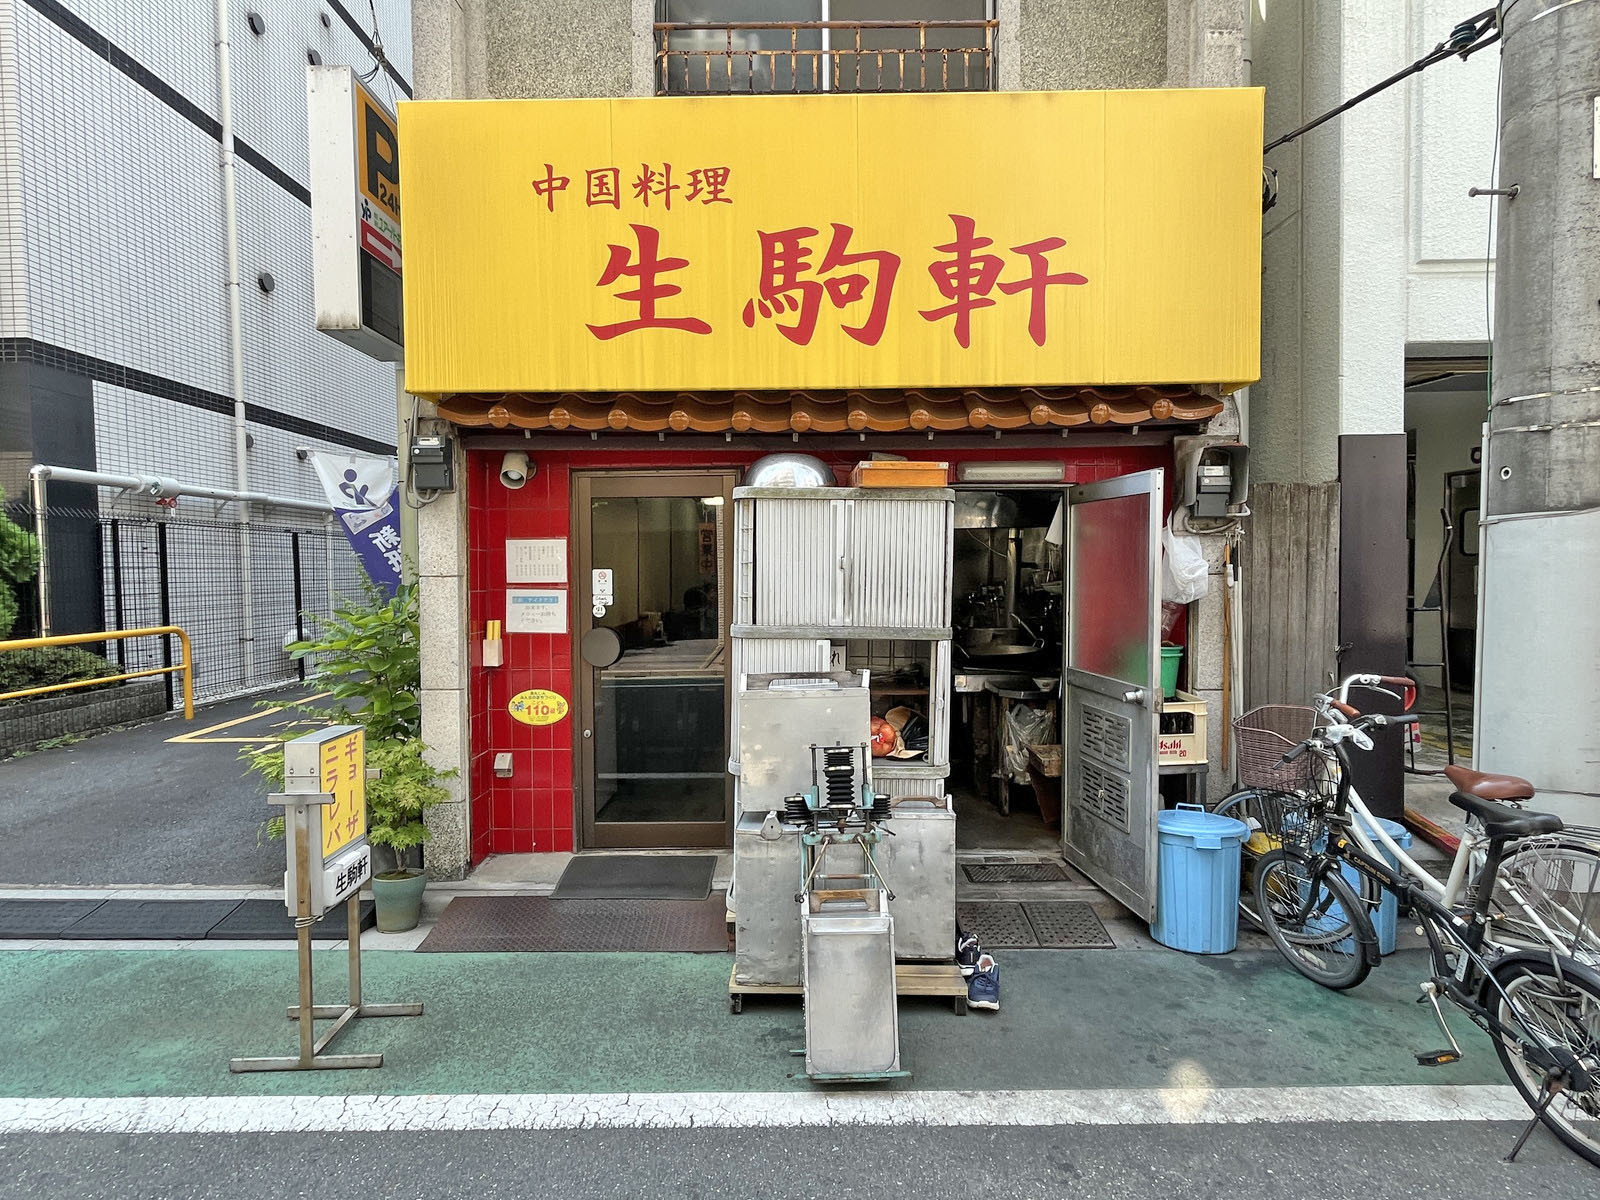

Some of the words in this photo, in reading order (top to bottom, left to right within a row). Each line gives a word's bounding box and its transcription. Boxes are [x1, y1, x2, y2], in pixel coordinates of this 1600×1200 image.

[365, 102, 399, 200] P
[531, 163, 733, 212] 中国料理
[585, 214, 1089, 349] 生駒軒
[326, 745, 341, 848] ニラレバ
[345, 734, 360, 839] ギョーザ
[1179, 749, 1188, 758] 20
[335, 854, 369, 897] 生駒軒
